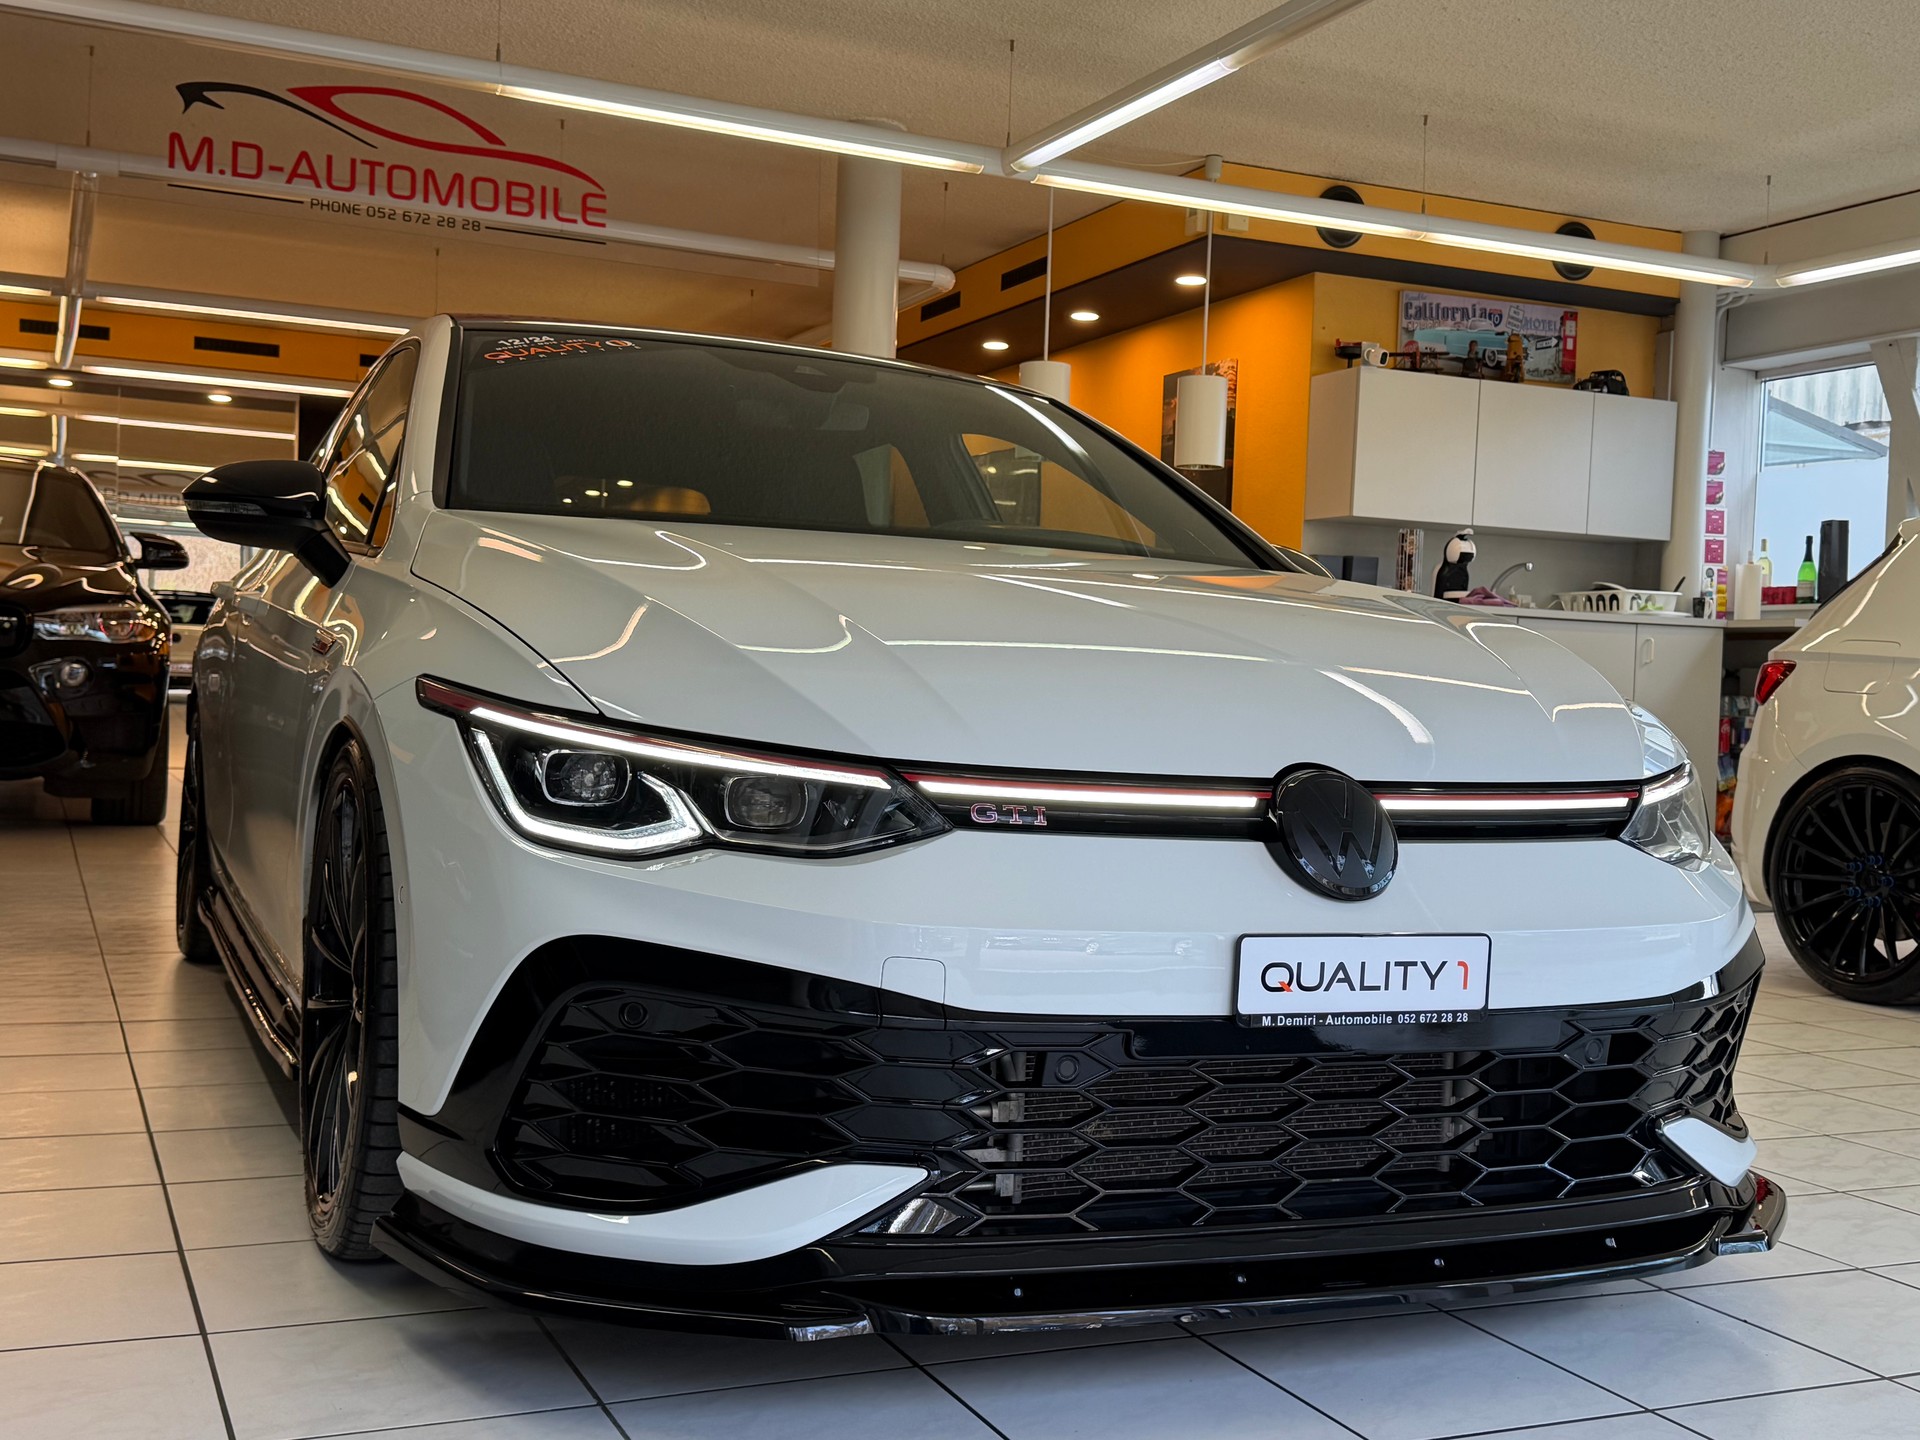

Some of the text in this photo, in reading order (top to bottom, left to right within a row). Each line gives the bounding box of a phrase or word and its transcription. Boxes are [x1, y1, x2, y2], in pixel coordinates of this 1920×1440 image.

[167, 131, 607, 228] M.D-AUTOMOBILE
[310, 198, 481, 232] PHONE 052 672 28 28
[1404, 301, 1488, 322] California
[1491, 313, 1500, 325] 10
[484, 341, 602, 360] QUALITY
[970, 802, 1048, 826] GTI
[1260, 960, 1449, 993] QUALITY
[1325, 1013, 1393, 1026] Automobile
[1397, 1013, 1416, 1024] 052
[1420, 1013, 1438, 1023] 672
[1441, 1012, 1453, 1023] 28
[1456, 1012, 1469, 1023] 28
